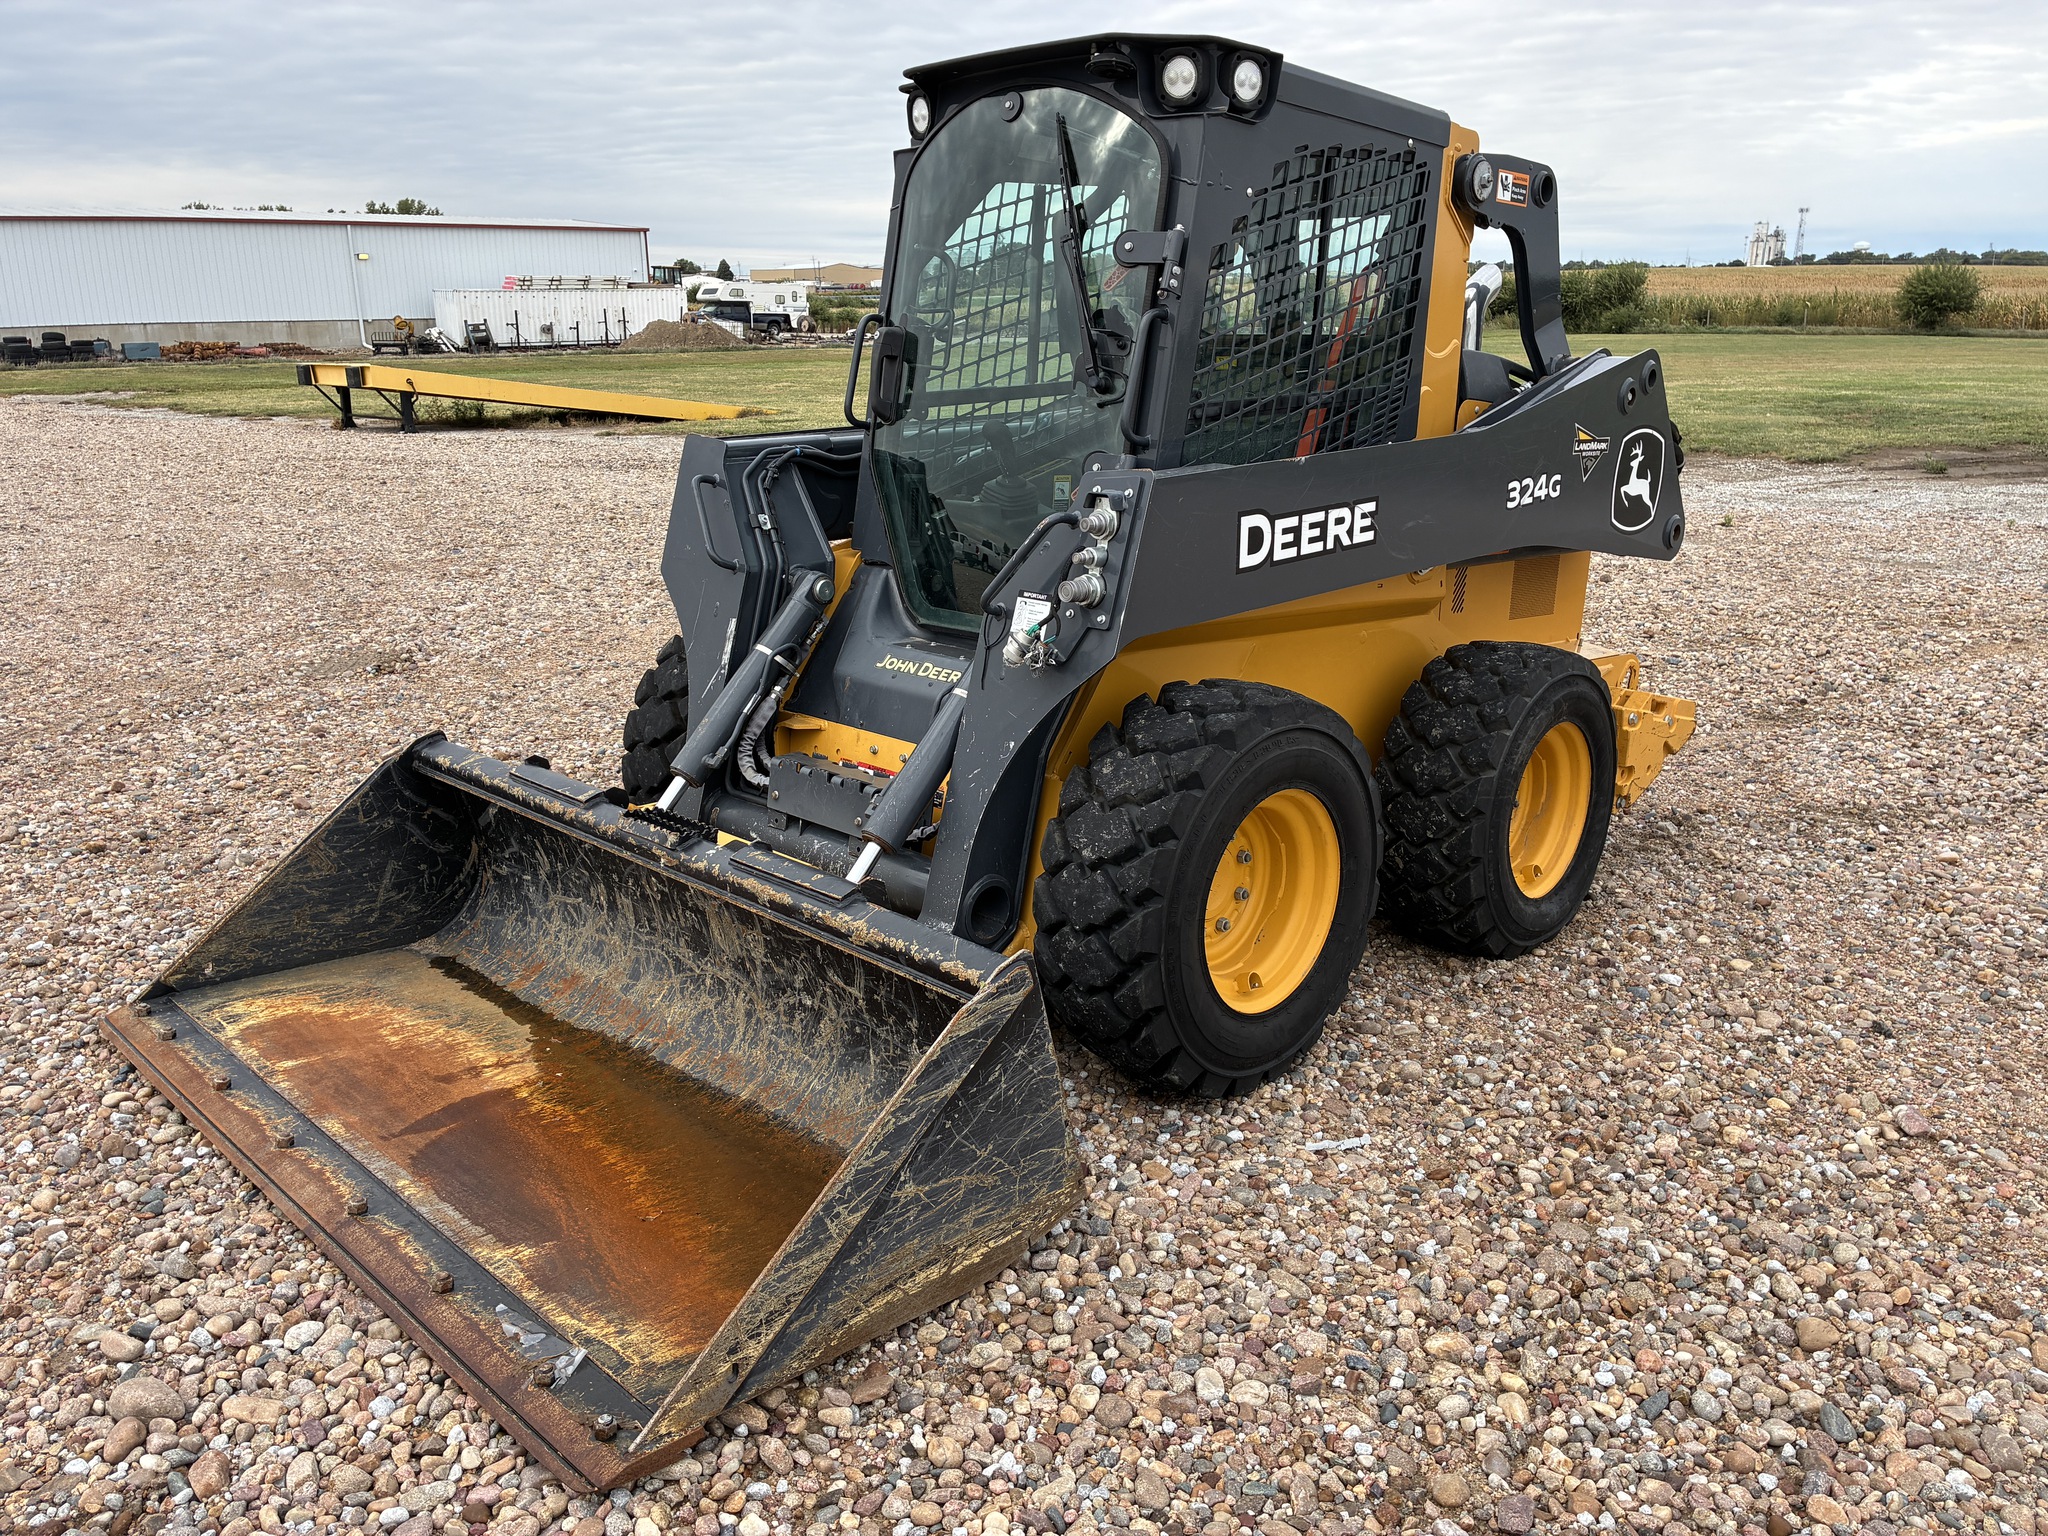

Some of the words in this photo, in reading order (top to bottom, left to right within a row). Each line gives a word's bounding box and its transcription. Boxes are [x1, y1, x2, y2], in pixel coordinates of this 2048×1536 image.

[1506, 473, 1562, 509] 324G
[1239, 501, 1377, 569] DEERE
[1023, 591, 1047, 600] IMPORTANT
[876, 653, 919, 675] JOHN
[917, 661, 962, 683] DEER
